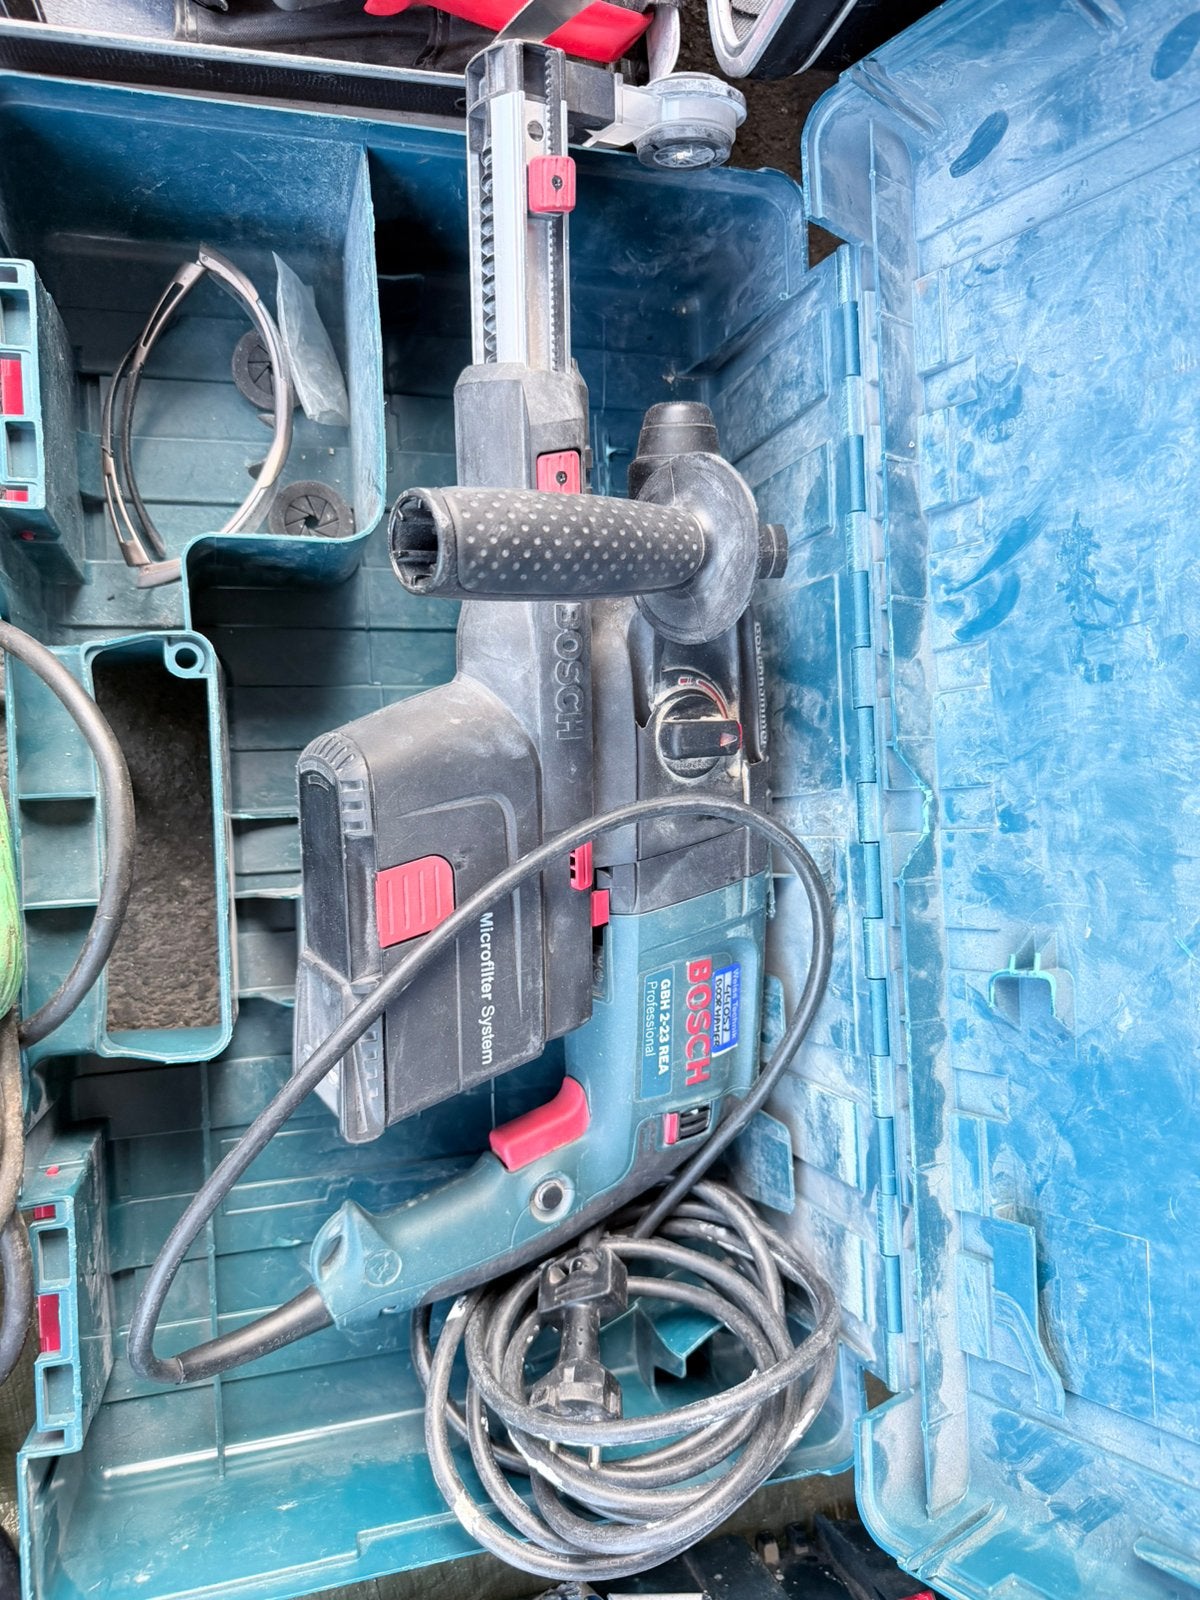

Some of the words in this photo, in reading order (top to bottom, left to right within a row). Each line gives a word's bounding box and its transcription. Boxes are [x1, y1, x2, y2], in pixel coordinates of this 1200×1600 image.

[554, 602, 584, 740] BOSCH
[479, 912, 495, 1001] Microfilter
[645, 981, 658, 1057] Professional
[660, 979, 671, 1010] GBH
[685, 958, 712, 1086] BOSCH
[731, 1000, 739, 1039] Technik
[478, 1005, 495, 1065] System
[659, 1013, 671, 1043] 2-23
[658, 1045, 670, 1075] REA
